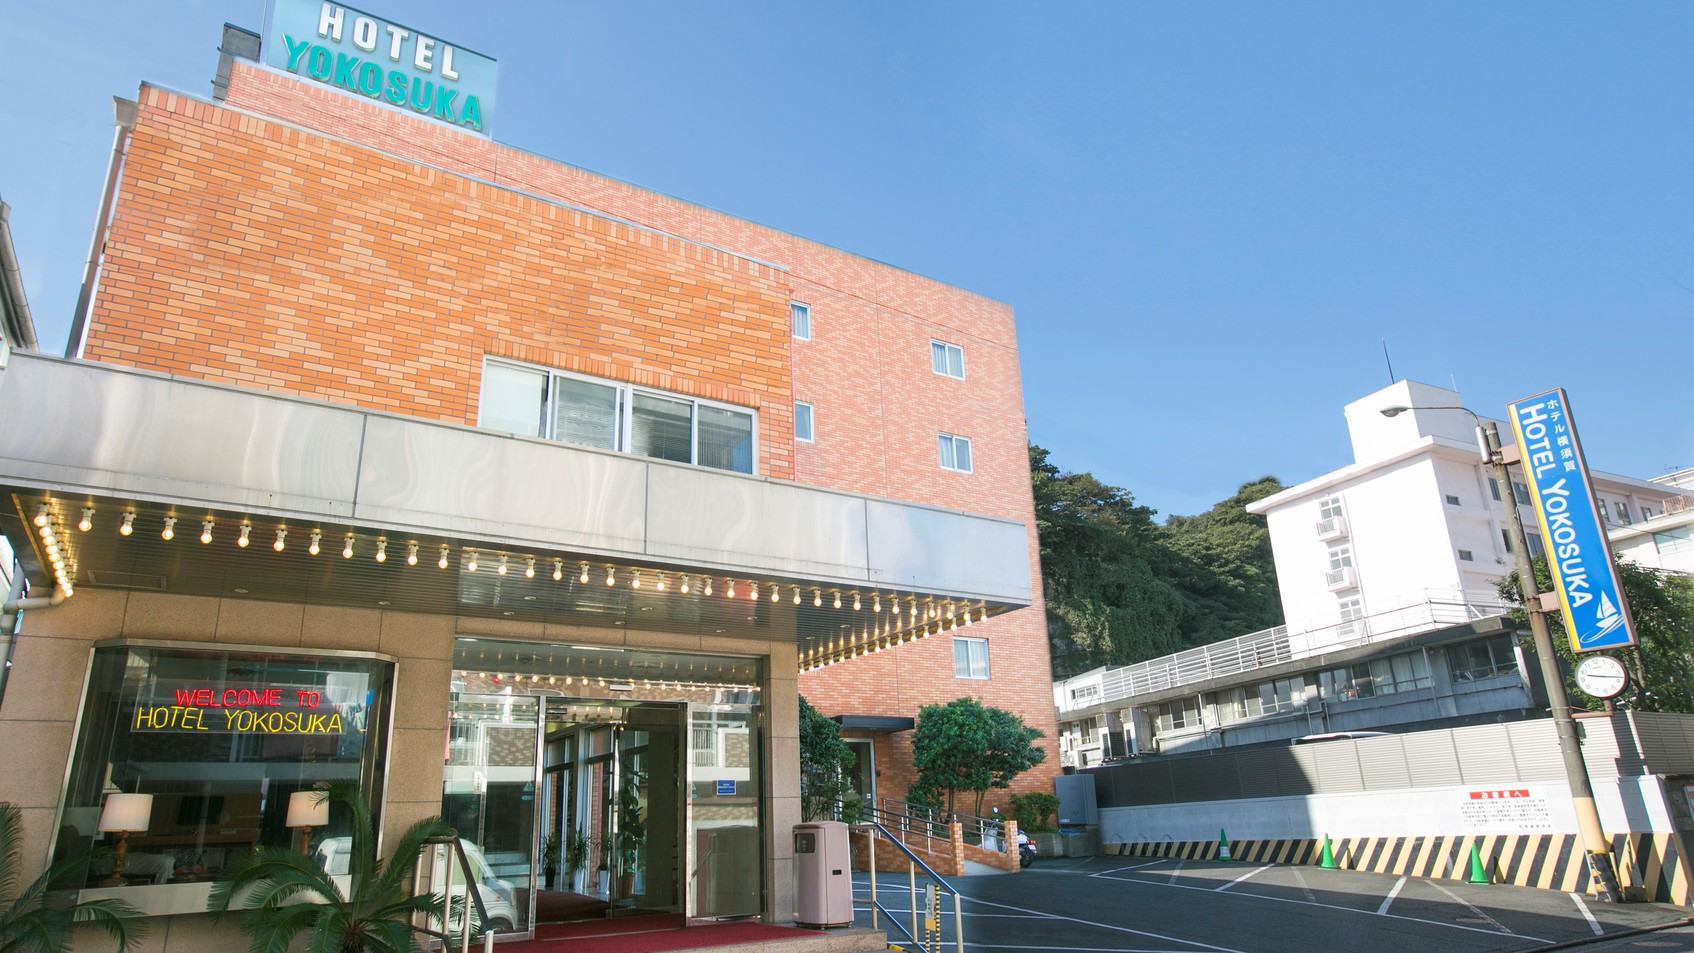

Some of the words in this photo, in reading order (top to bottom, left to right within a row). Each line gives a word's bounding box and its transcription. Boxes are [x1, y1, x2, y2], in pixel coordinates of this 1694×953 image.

[317, 3, 459, 81] HOTEL
[282, 33, 482, 130] YOKOSUKA
[1546, 399, 1577, 472] ホテル横須賀
[1519, 402, 1557, 479] HOTEL
[1541, 477, 1594, 608] YOKOSUKA
[136, 705, 209, 730] HOTEL
[225, 709, 342, 734] YOKOSUKA
[175, 688, 283, 709] WELCOME
[296, 690, 321, 710] TO
